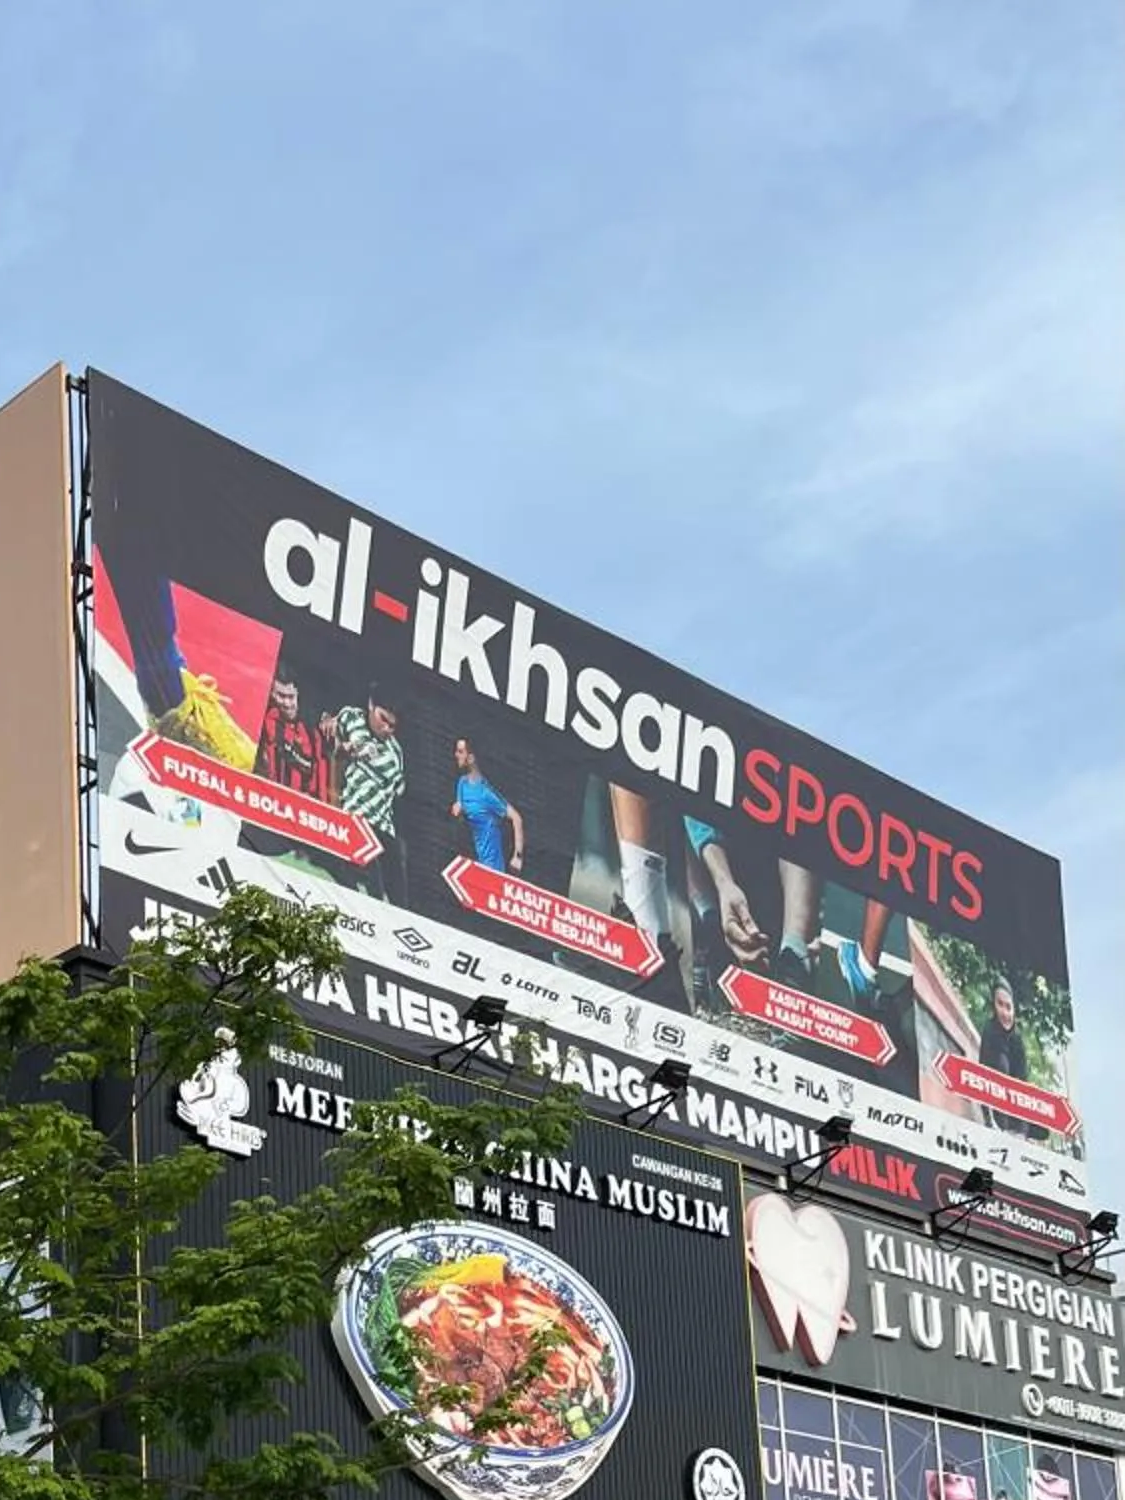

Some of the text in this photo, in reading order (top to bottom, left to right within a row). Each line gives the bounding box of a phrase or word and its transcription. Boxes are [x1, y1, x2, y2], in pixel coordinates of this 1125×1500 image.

[264, 517, 983, 921] al-ikhsan SPORTS
[163, 755, 351, 845] FUTSAL & BOLA SEPAK
[487, 893, 624, 961] & KASUT BERJALAN
[503, 882, 608, 938] KASUT LARIAN
[768, 987, 807, 1013] KASUT
[775, 1005, 814, 1035] KASUT
[269, 1044, 344, 1081] RESTORAN
[794, 1075, 830, 1104] FILA
[632, 1154, 692, 1184] CAWANGAN
[686, 1084, 823, 1169] MAMPU
[829, 1142, 922, 1200] MILIK
[606, 1174, 731, 1236] MUSLIM
[865, 1229, 1116, 1338] KLINIK PERGIGIAN
[870, 1280, 1125, 1399] LUMIERE
